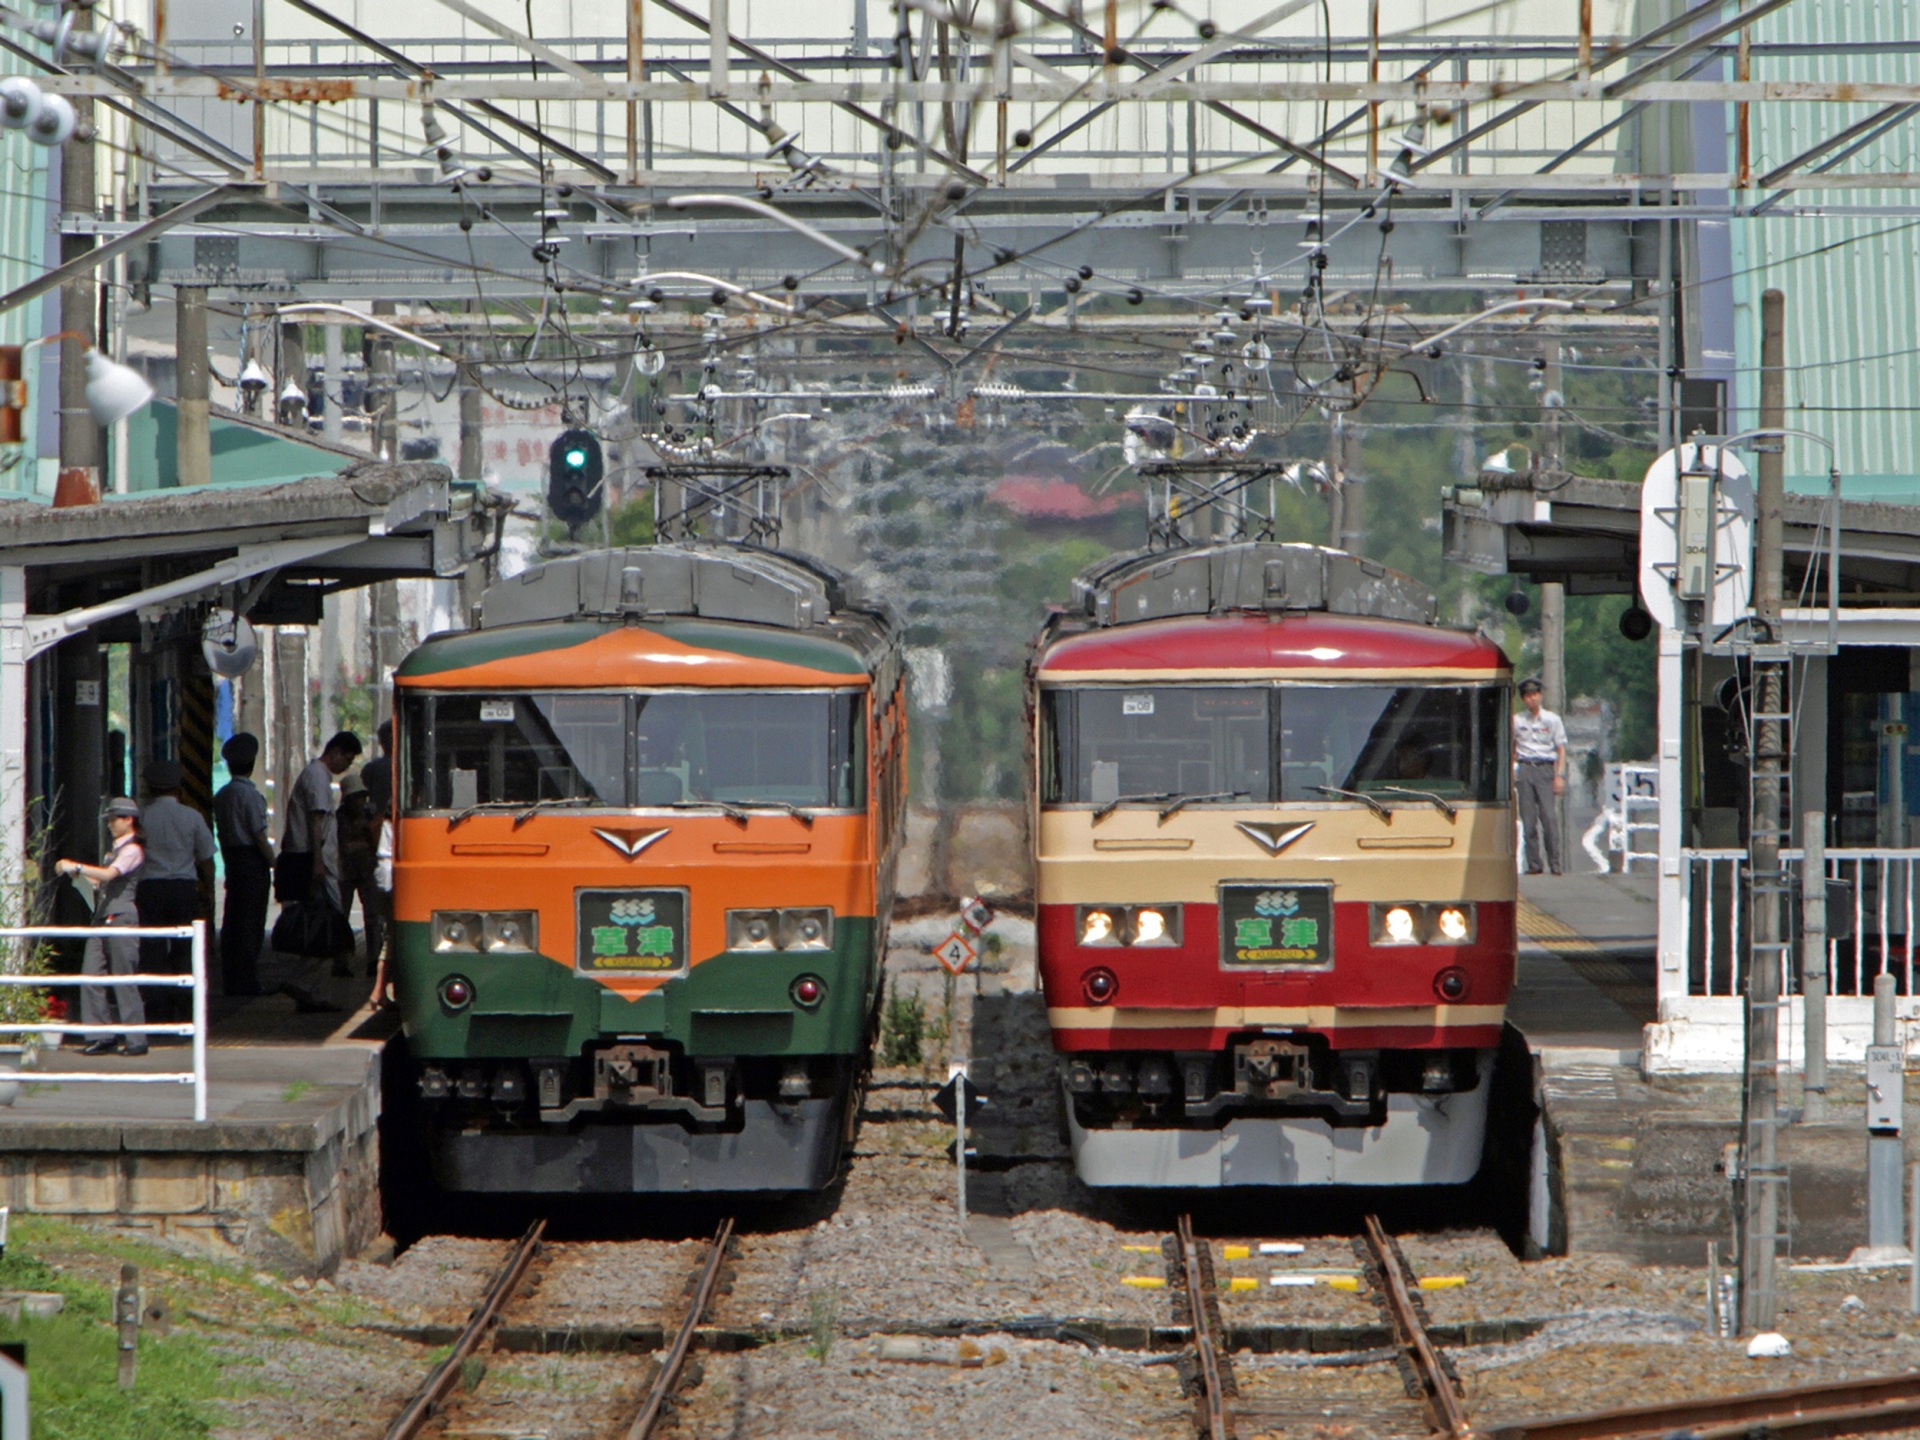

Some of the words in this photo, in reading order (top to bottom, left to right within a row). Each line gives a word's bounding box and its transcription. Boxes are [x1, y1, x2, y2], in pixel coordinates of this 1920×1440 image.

[591, 925, 675, 956] 草津
[1234, 917, 1318, 949] 草津
[949, 943, 961, 962] 4
